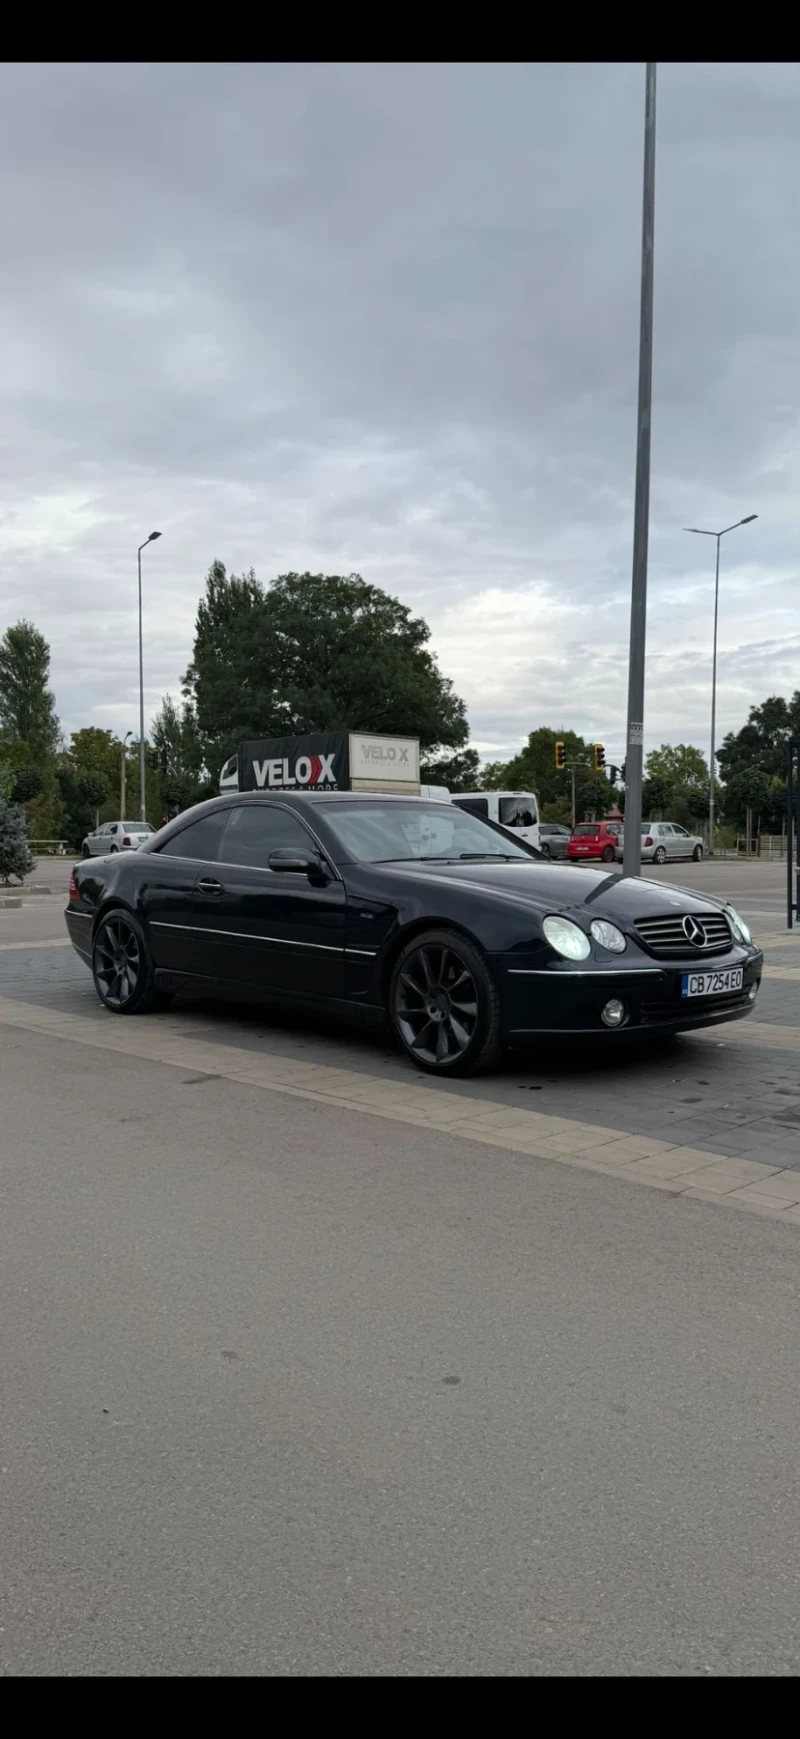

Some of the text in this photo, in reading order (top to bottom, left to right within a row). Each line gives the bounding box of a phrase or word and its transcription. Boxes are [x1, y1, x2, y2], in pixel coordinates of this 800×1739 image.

[252, 753, 337, 787] VELOX
[690, 975, 704, 993] CB
[707, 972, 730, 992] 7254
